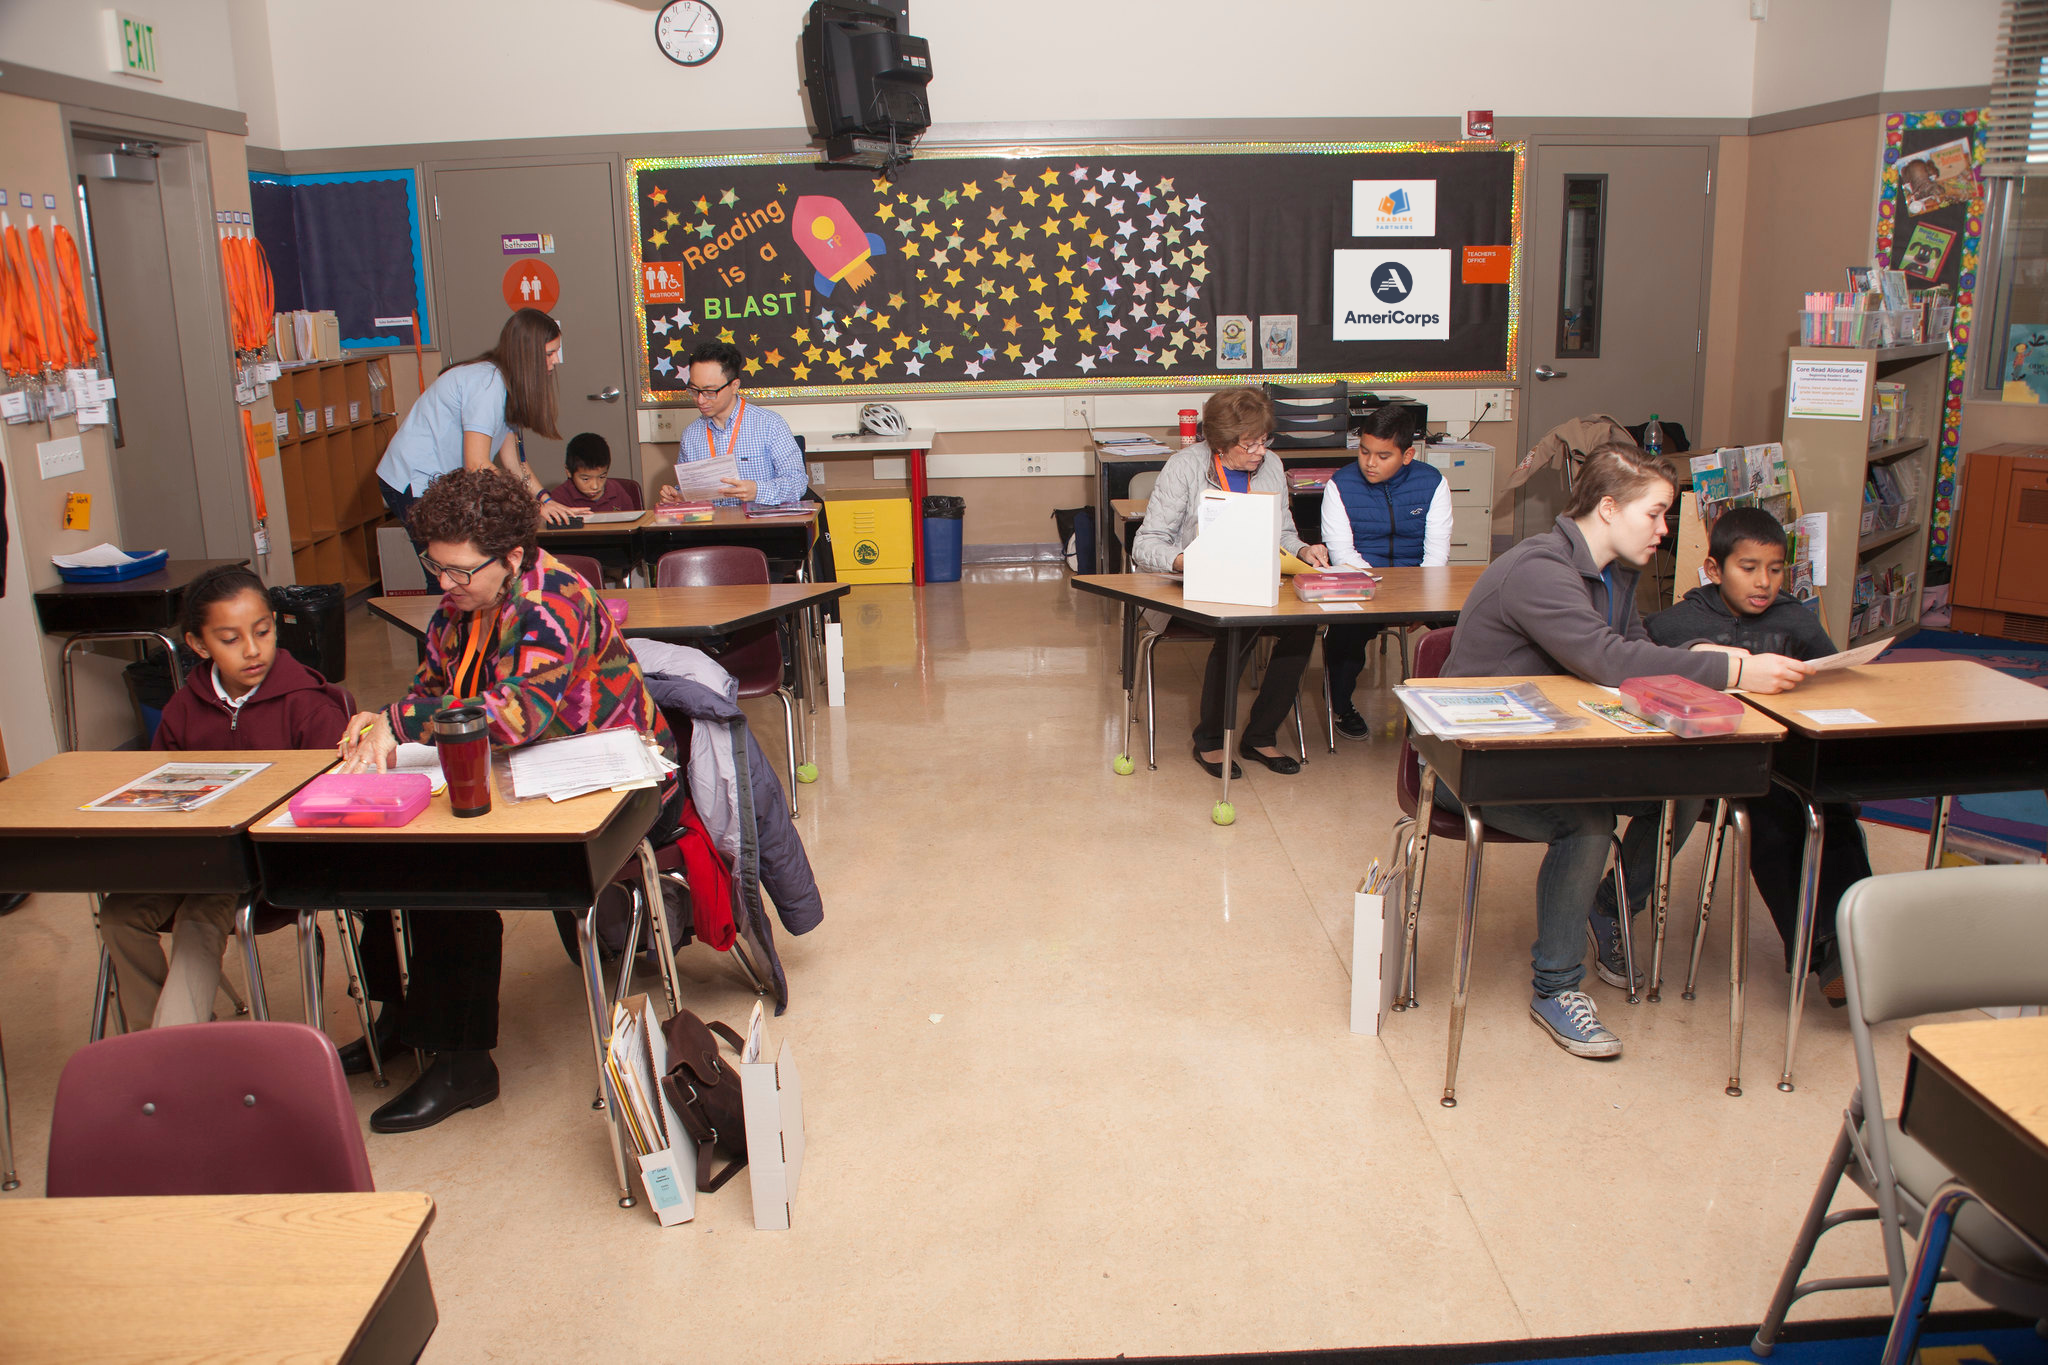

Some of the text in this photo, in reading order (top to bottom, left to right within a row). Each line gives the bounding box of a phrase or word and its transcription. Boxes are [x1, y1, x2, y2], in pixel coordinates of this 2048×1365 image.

[123, 18, 156, 72] EXIT
[504, 240, 538, 249] bathroom
[683, 200, 786, 271] Reading
[718, 242, 778, 288] is a
[1344, 310, 1440, 327] AmeriCorps
